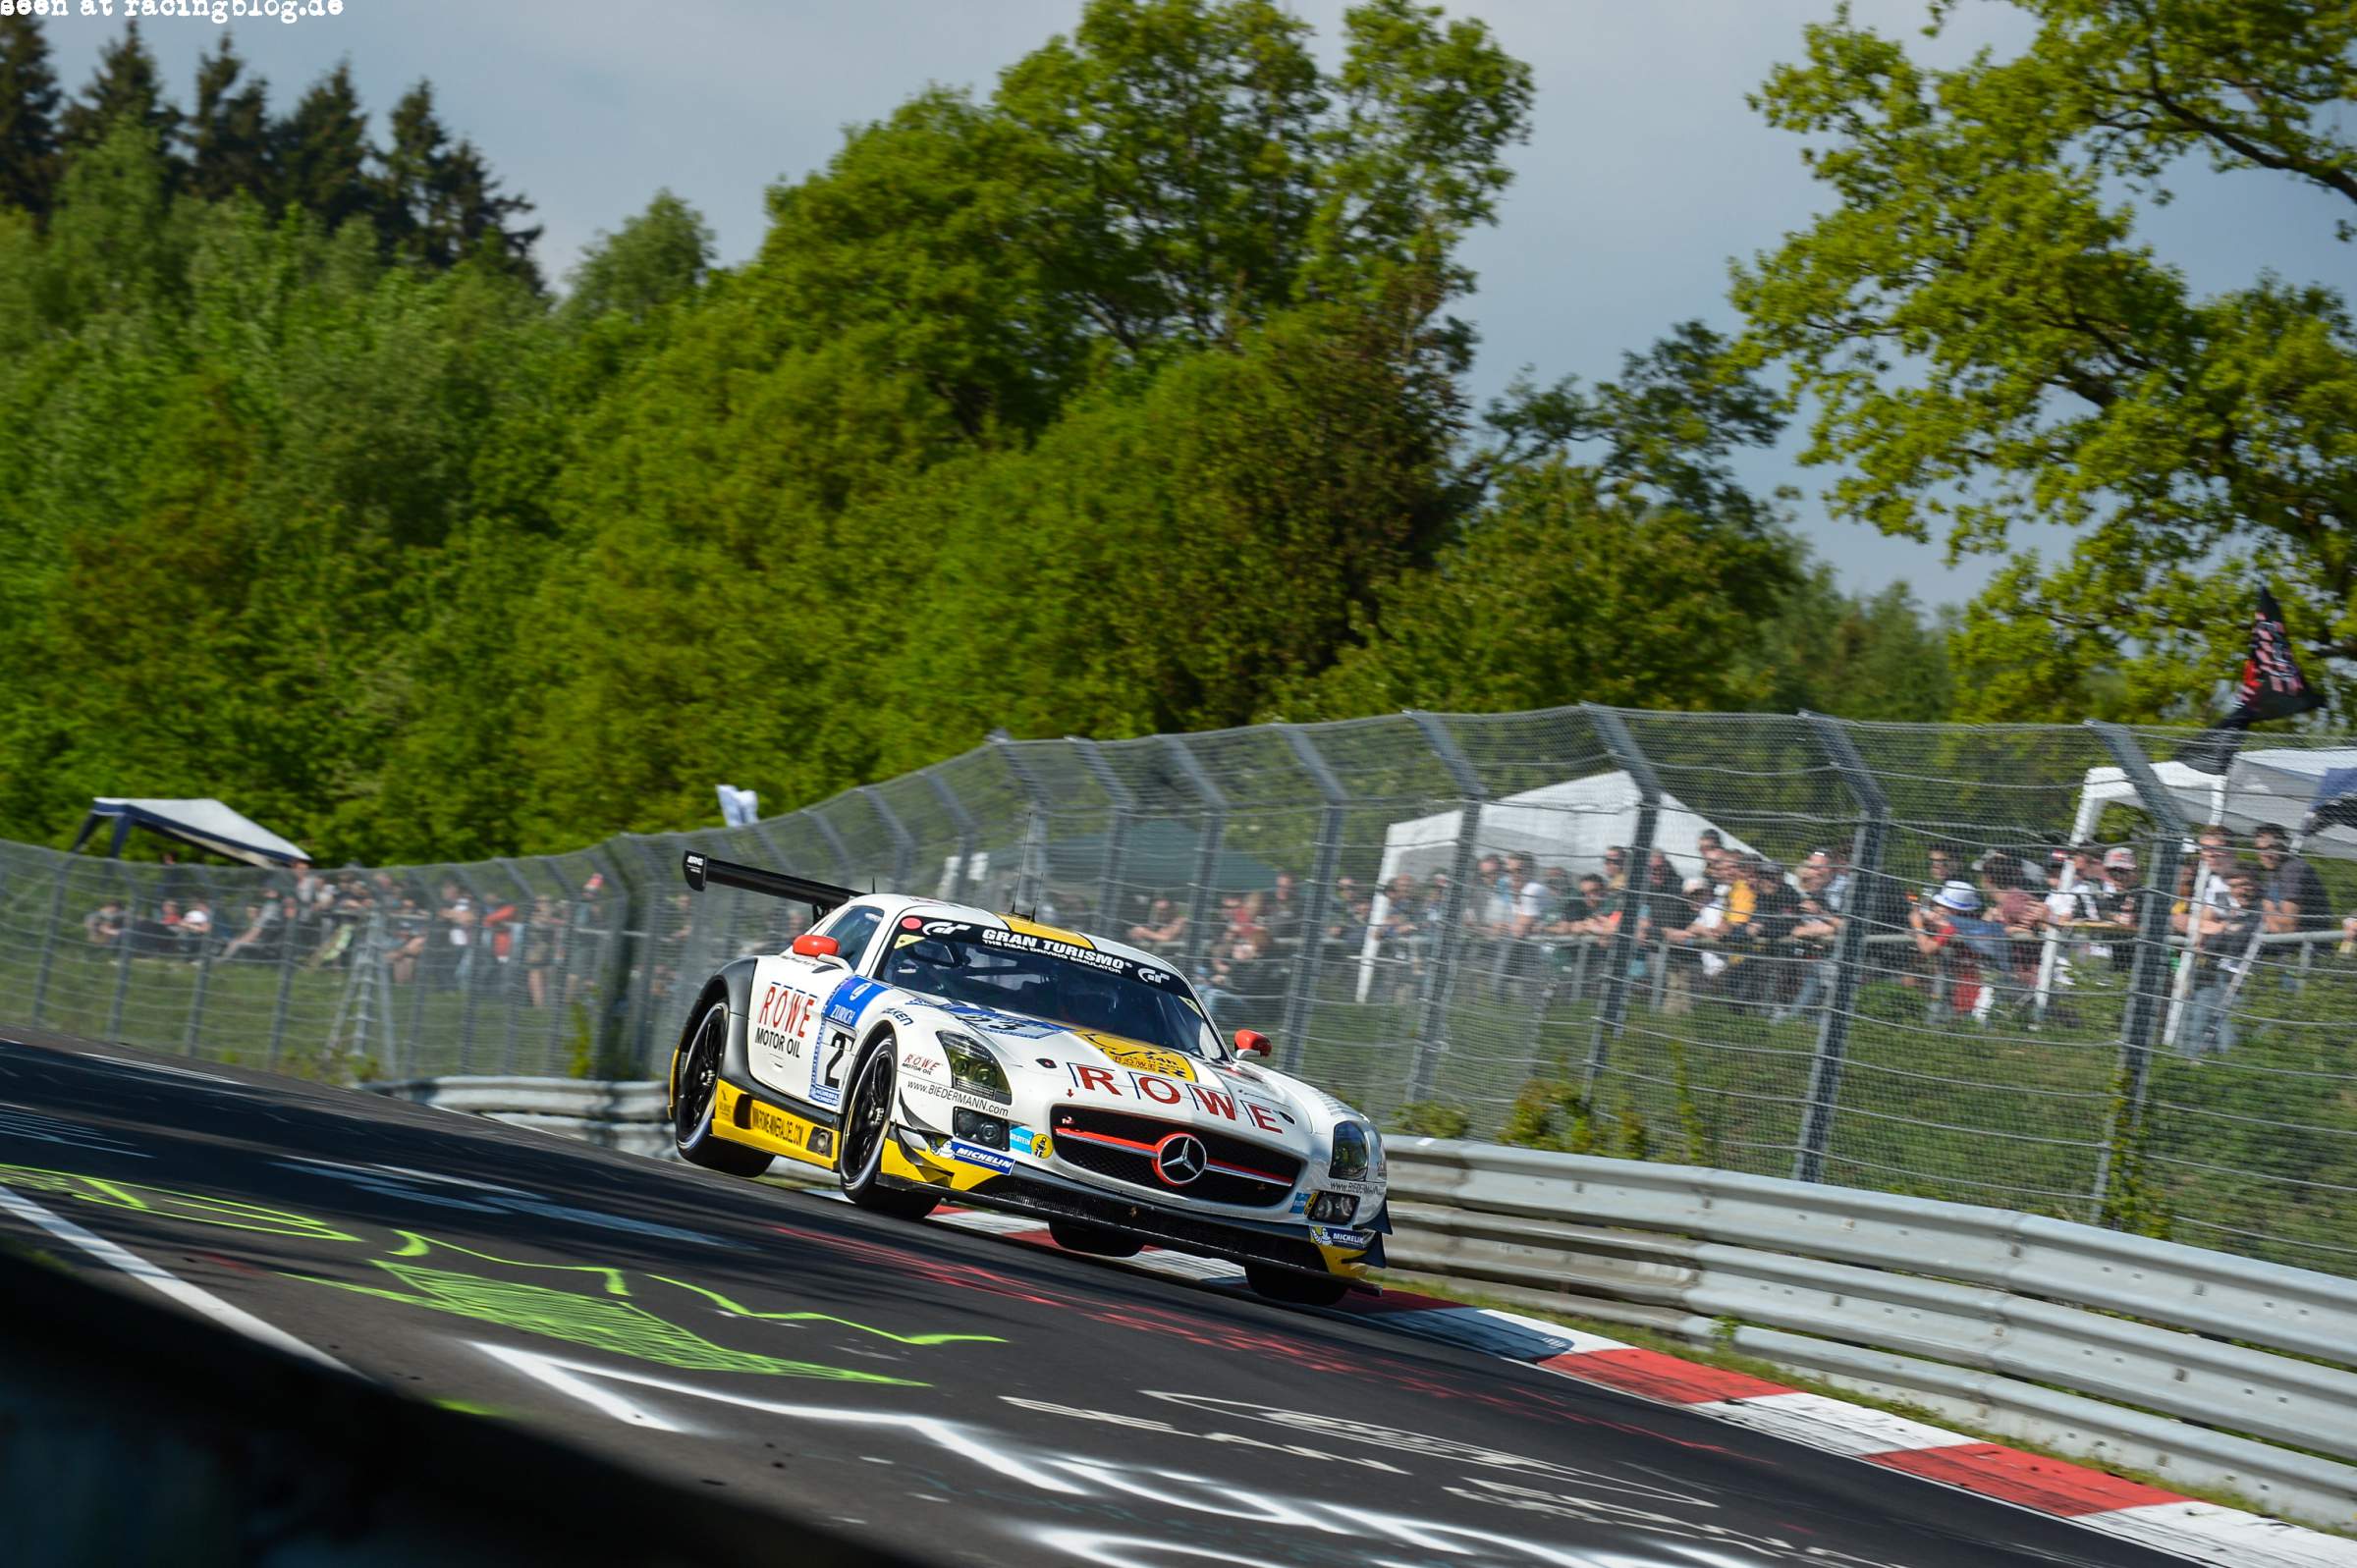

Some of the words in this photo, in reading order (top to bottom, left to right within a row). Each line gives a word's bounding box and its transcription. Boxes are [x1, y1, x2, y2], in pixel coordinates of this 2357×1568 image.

[982, 929, 1038, 947] GRAN
[1043, 940, 1124, 970] TURISMO
[758, 986, 814, 1038] ROWE
[830, 1003, 856, 1025] ZURICH
[755, 1027, 785, 1052] MOTOR
[786, 1038, 800, 1058] OIL
[904, 1053, 941, 1071] ROWE
[907, 1080, 1010, 1117] www.BIEDERMANN.com
[1076, 1064, 1283, 1135] ROWE
[956, 1147, 1013, 1167] MICHELIN
[1333, 1232, 1363, 1243] MICHELIN
